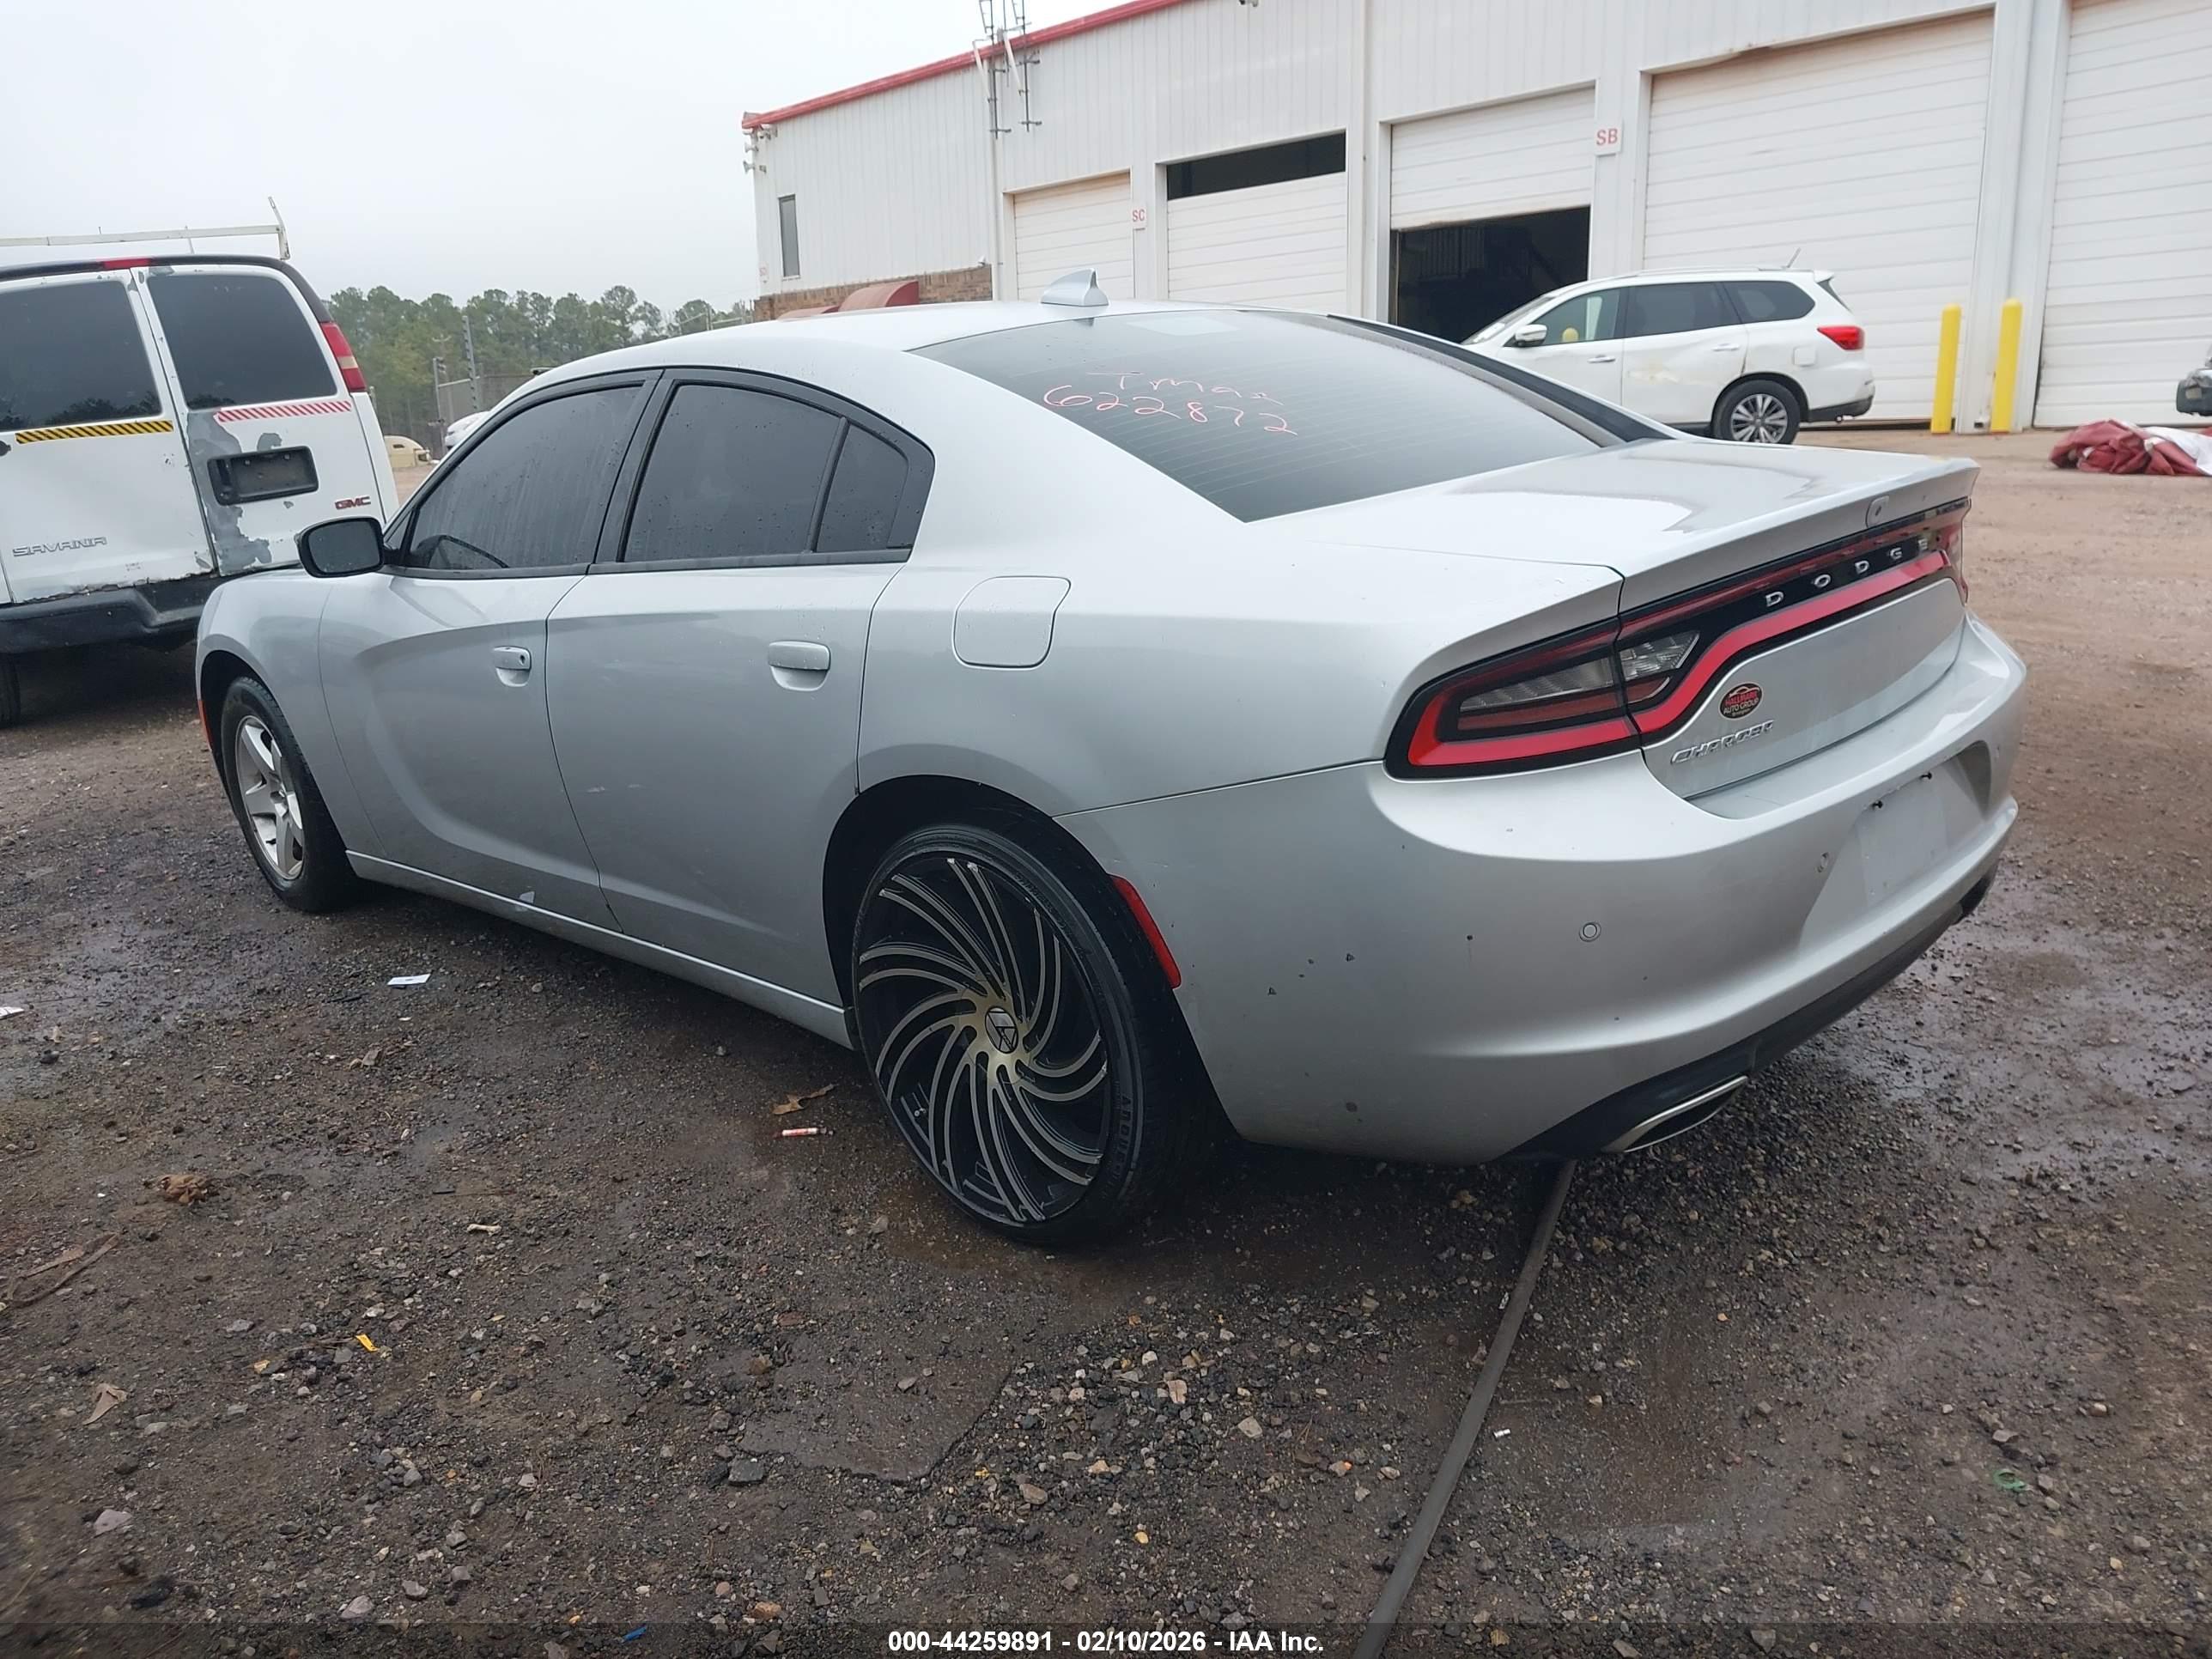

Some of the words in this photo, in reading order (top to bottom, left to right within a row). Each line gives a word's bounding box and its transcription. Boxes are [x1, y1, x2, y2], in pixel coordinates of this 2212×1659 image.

[1596, 128, 1618, 145] SB
[1133, 209, 1146, 222] SC
[1043, 385, 1298, 436] 622872
[335, 495, 371, 510] GMC
[12, 537, 107, 557] SAVANA
[1765, 538, 1929, 607] DODGE
[1723, 703, 1740, 714] AUTO
[1740, 697, 1759, 709] GROUP
[1670, 720, 1774, 763] CHARGER
